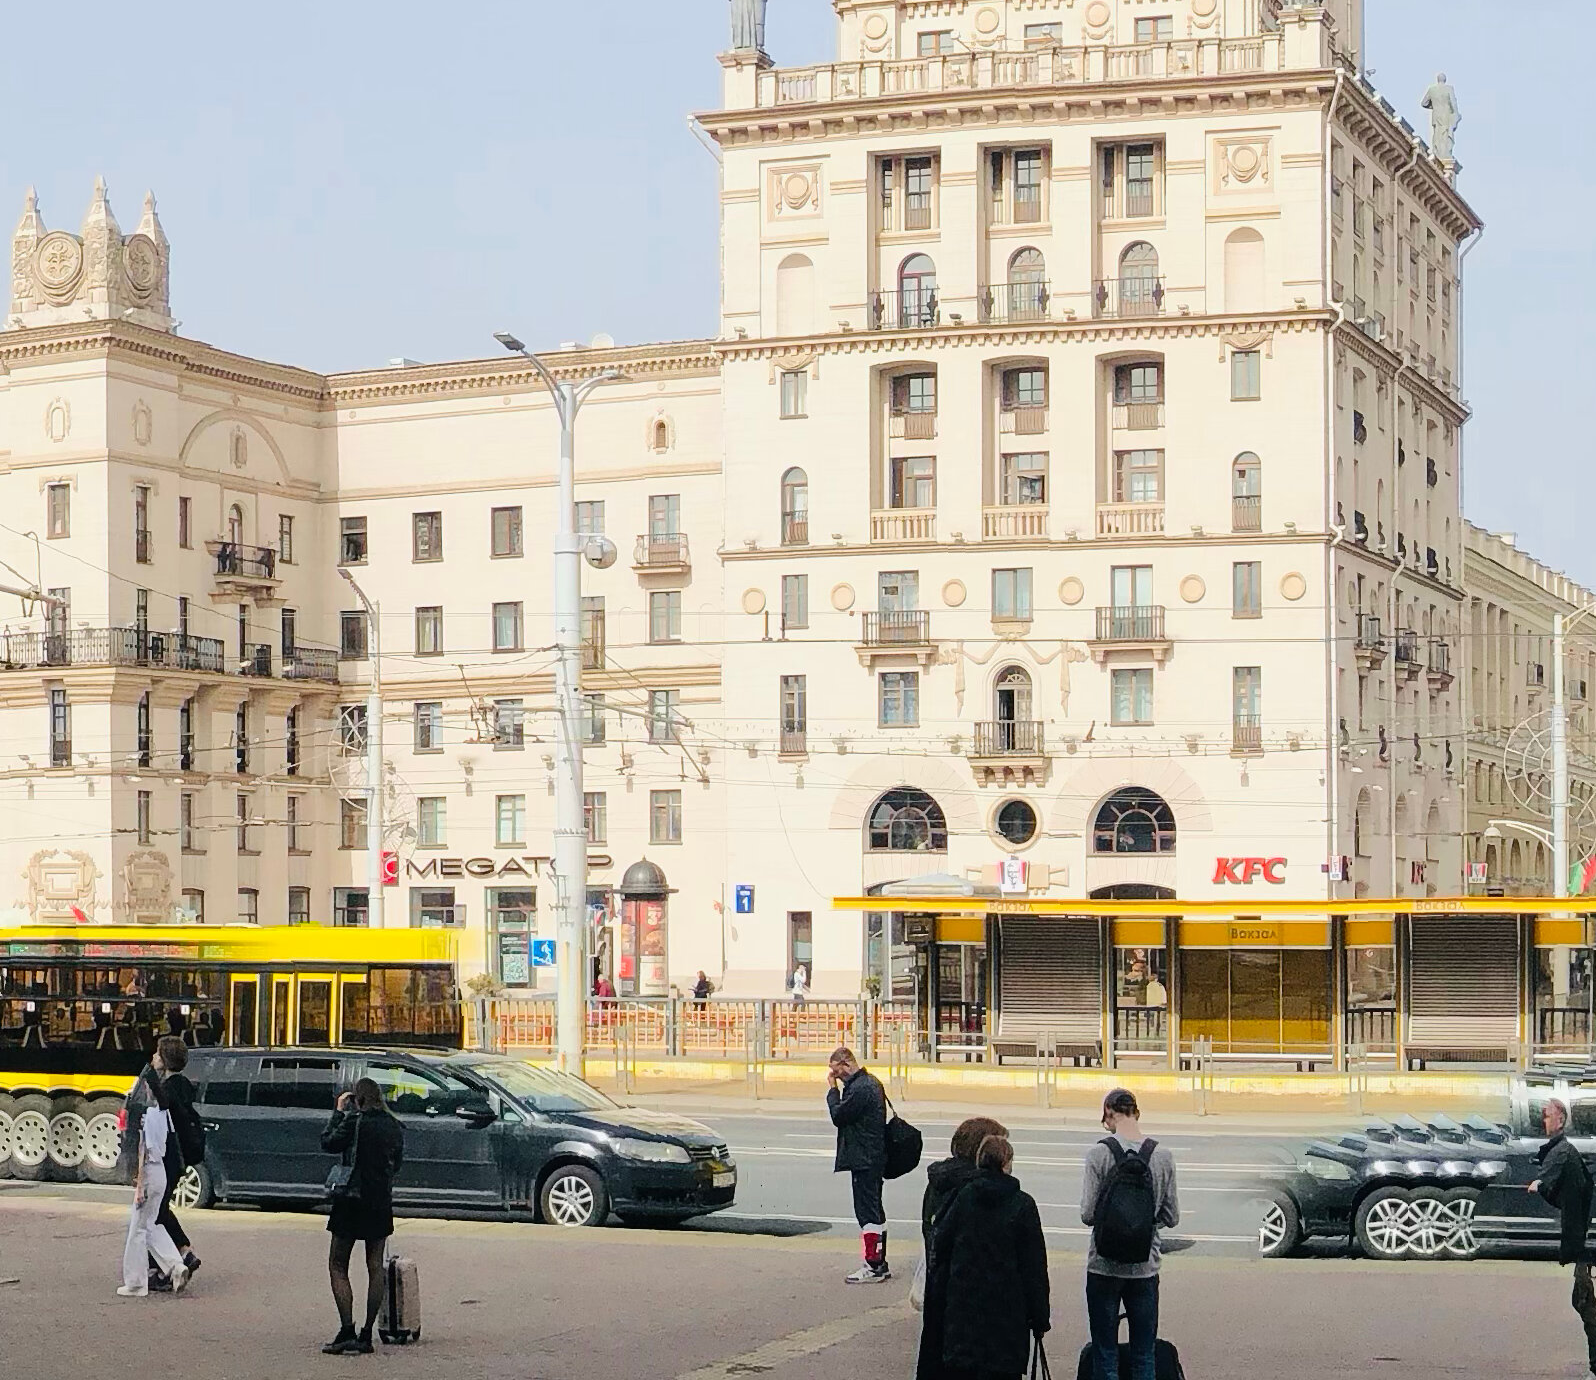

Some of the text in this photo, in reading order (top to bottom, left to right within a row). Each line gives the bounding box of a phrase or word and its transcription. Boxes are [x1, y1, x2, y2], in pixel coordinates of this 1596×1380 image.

[406, 854, 612, 878] MEGATP
[1211, 857, 1288, 885] KFC
[741, 898, 749, 912] 1
